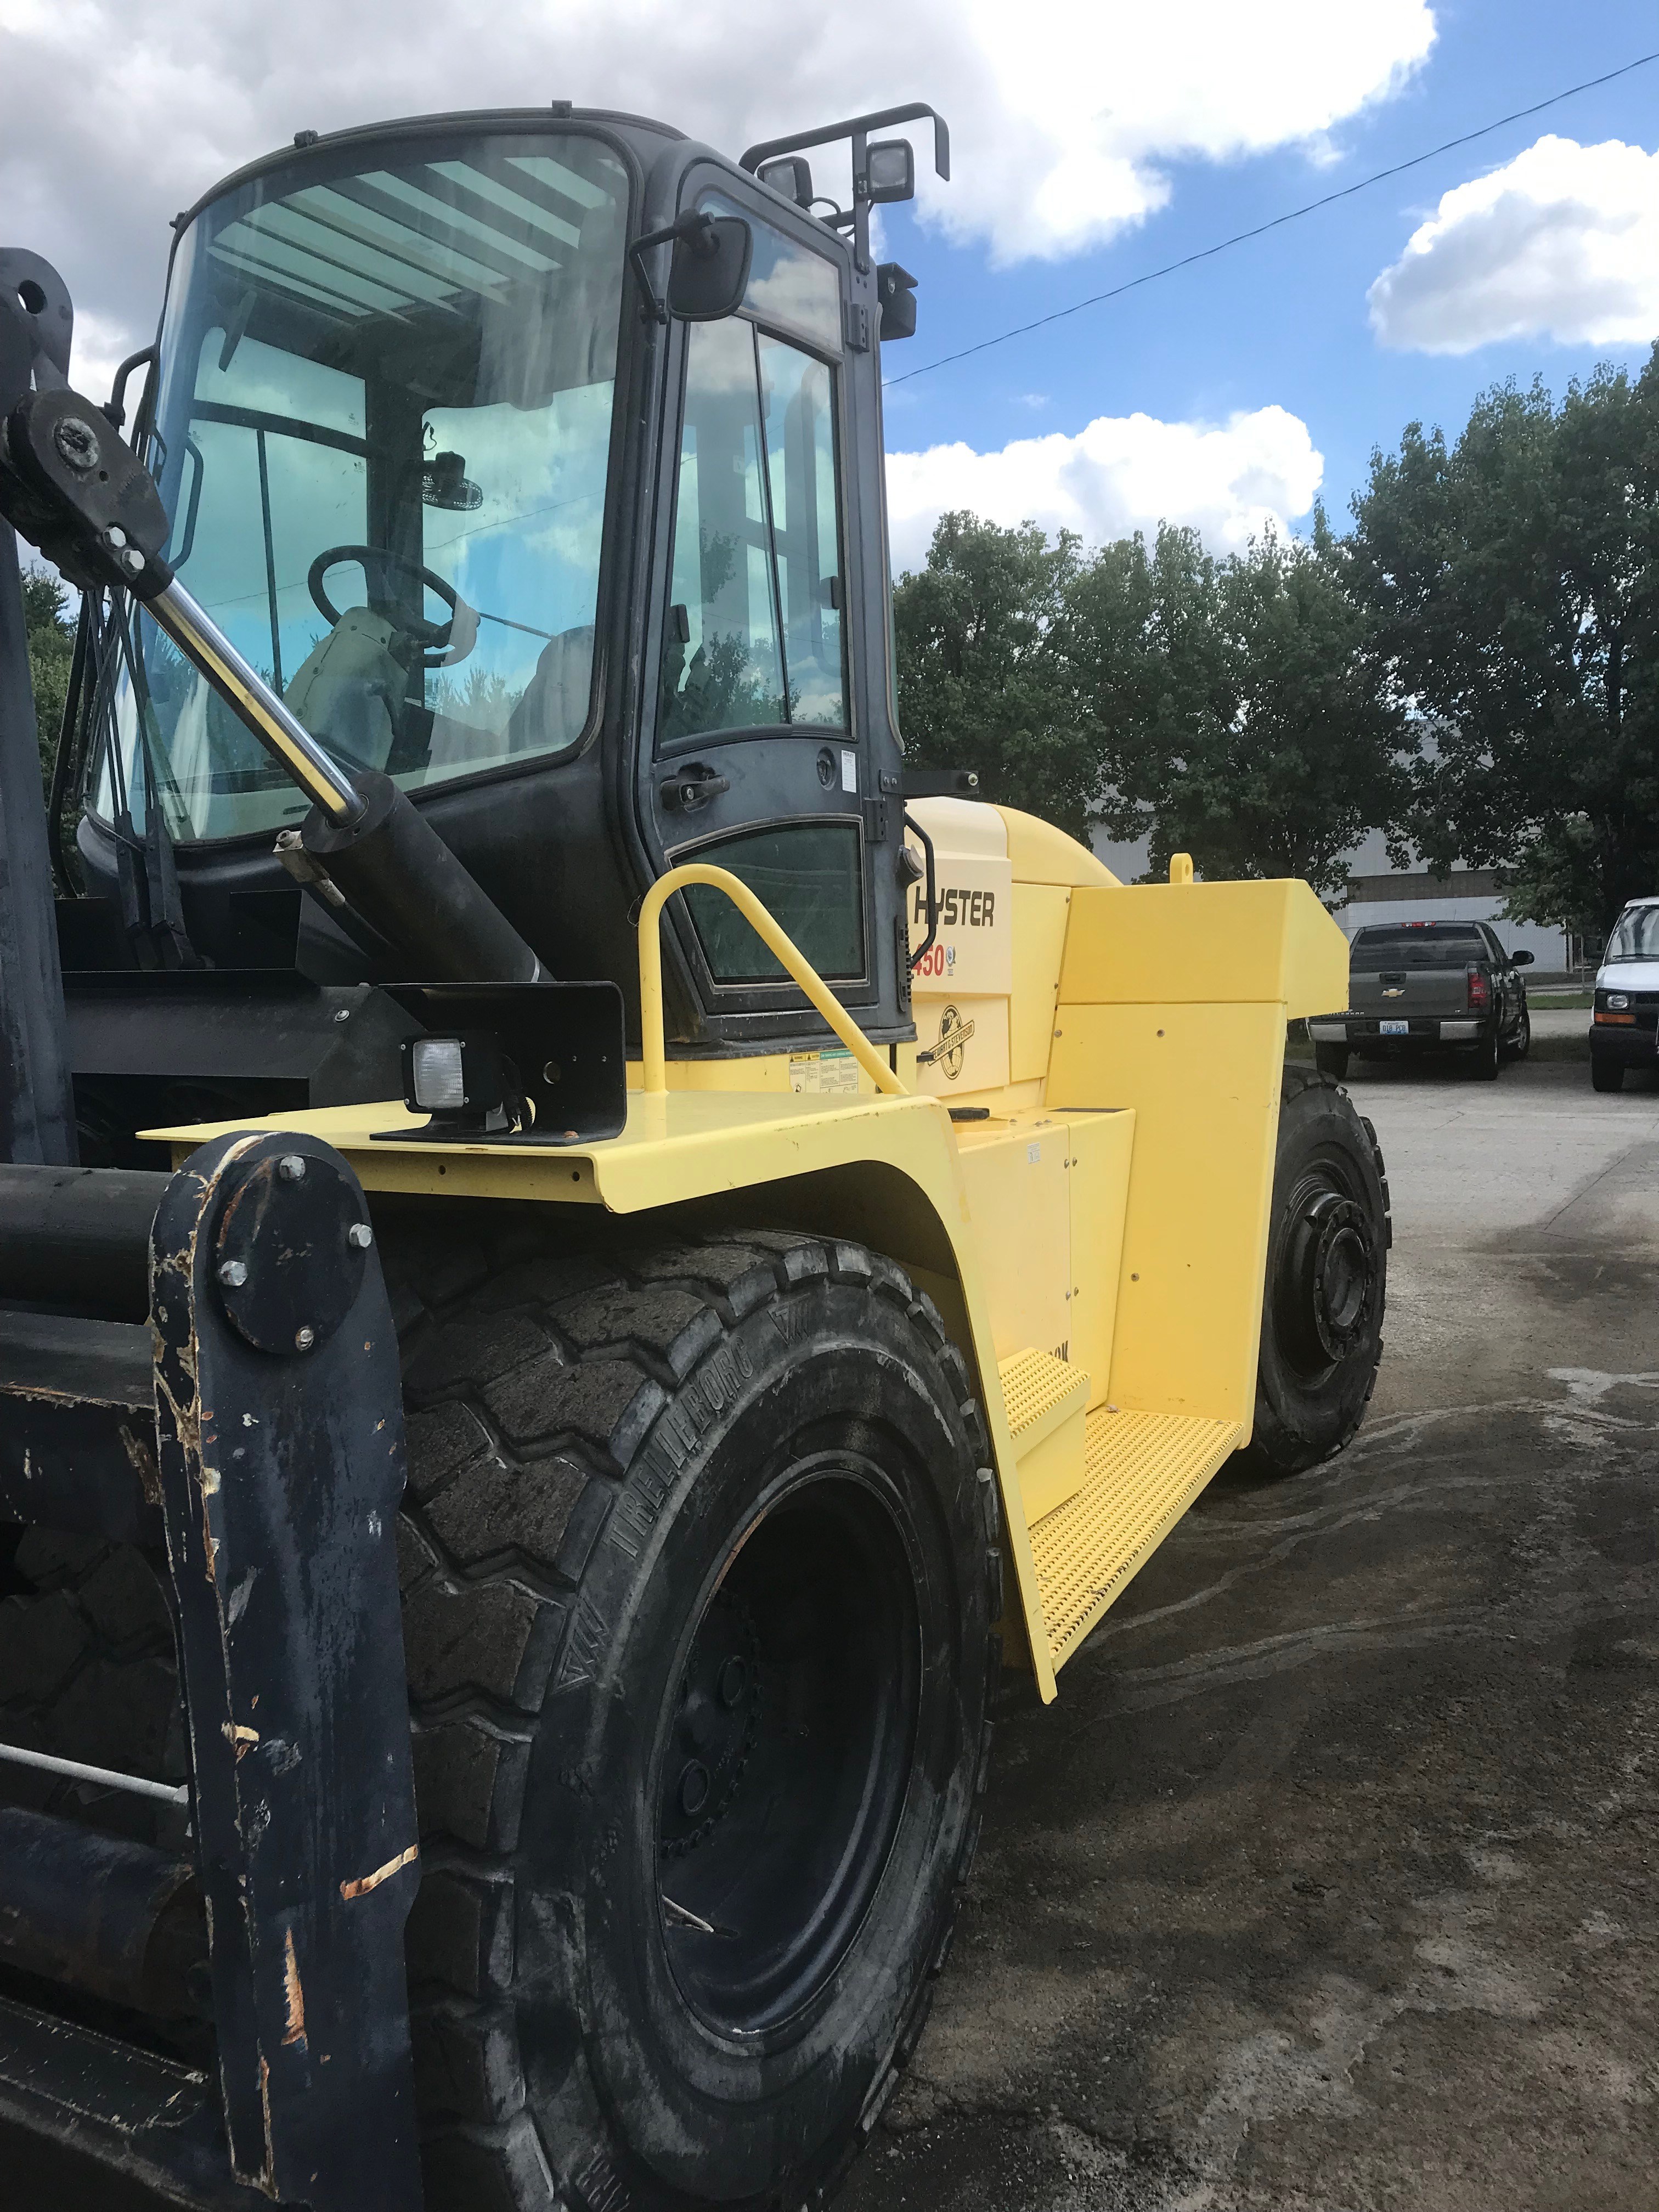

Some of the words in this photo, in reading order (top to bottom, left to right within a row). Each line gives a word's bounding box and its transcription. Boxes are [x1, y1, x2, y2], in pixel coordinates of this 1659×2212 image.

[914, 885, 995, 927] HYSTER
[912, 944, 944, 976] 450
[603, 1335, 753, 1560] TRELLEBORG
